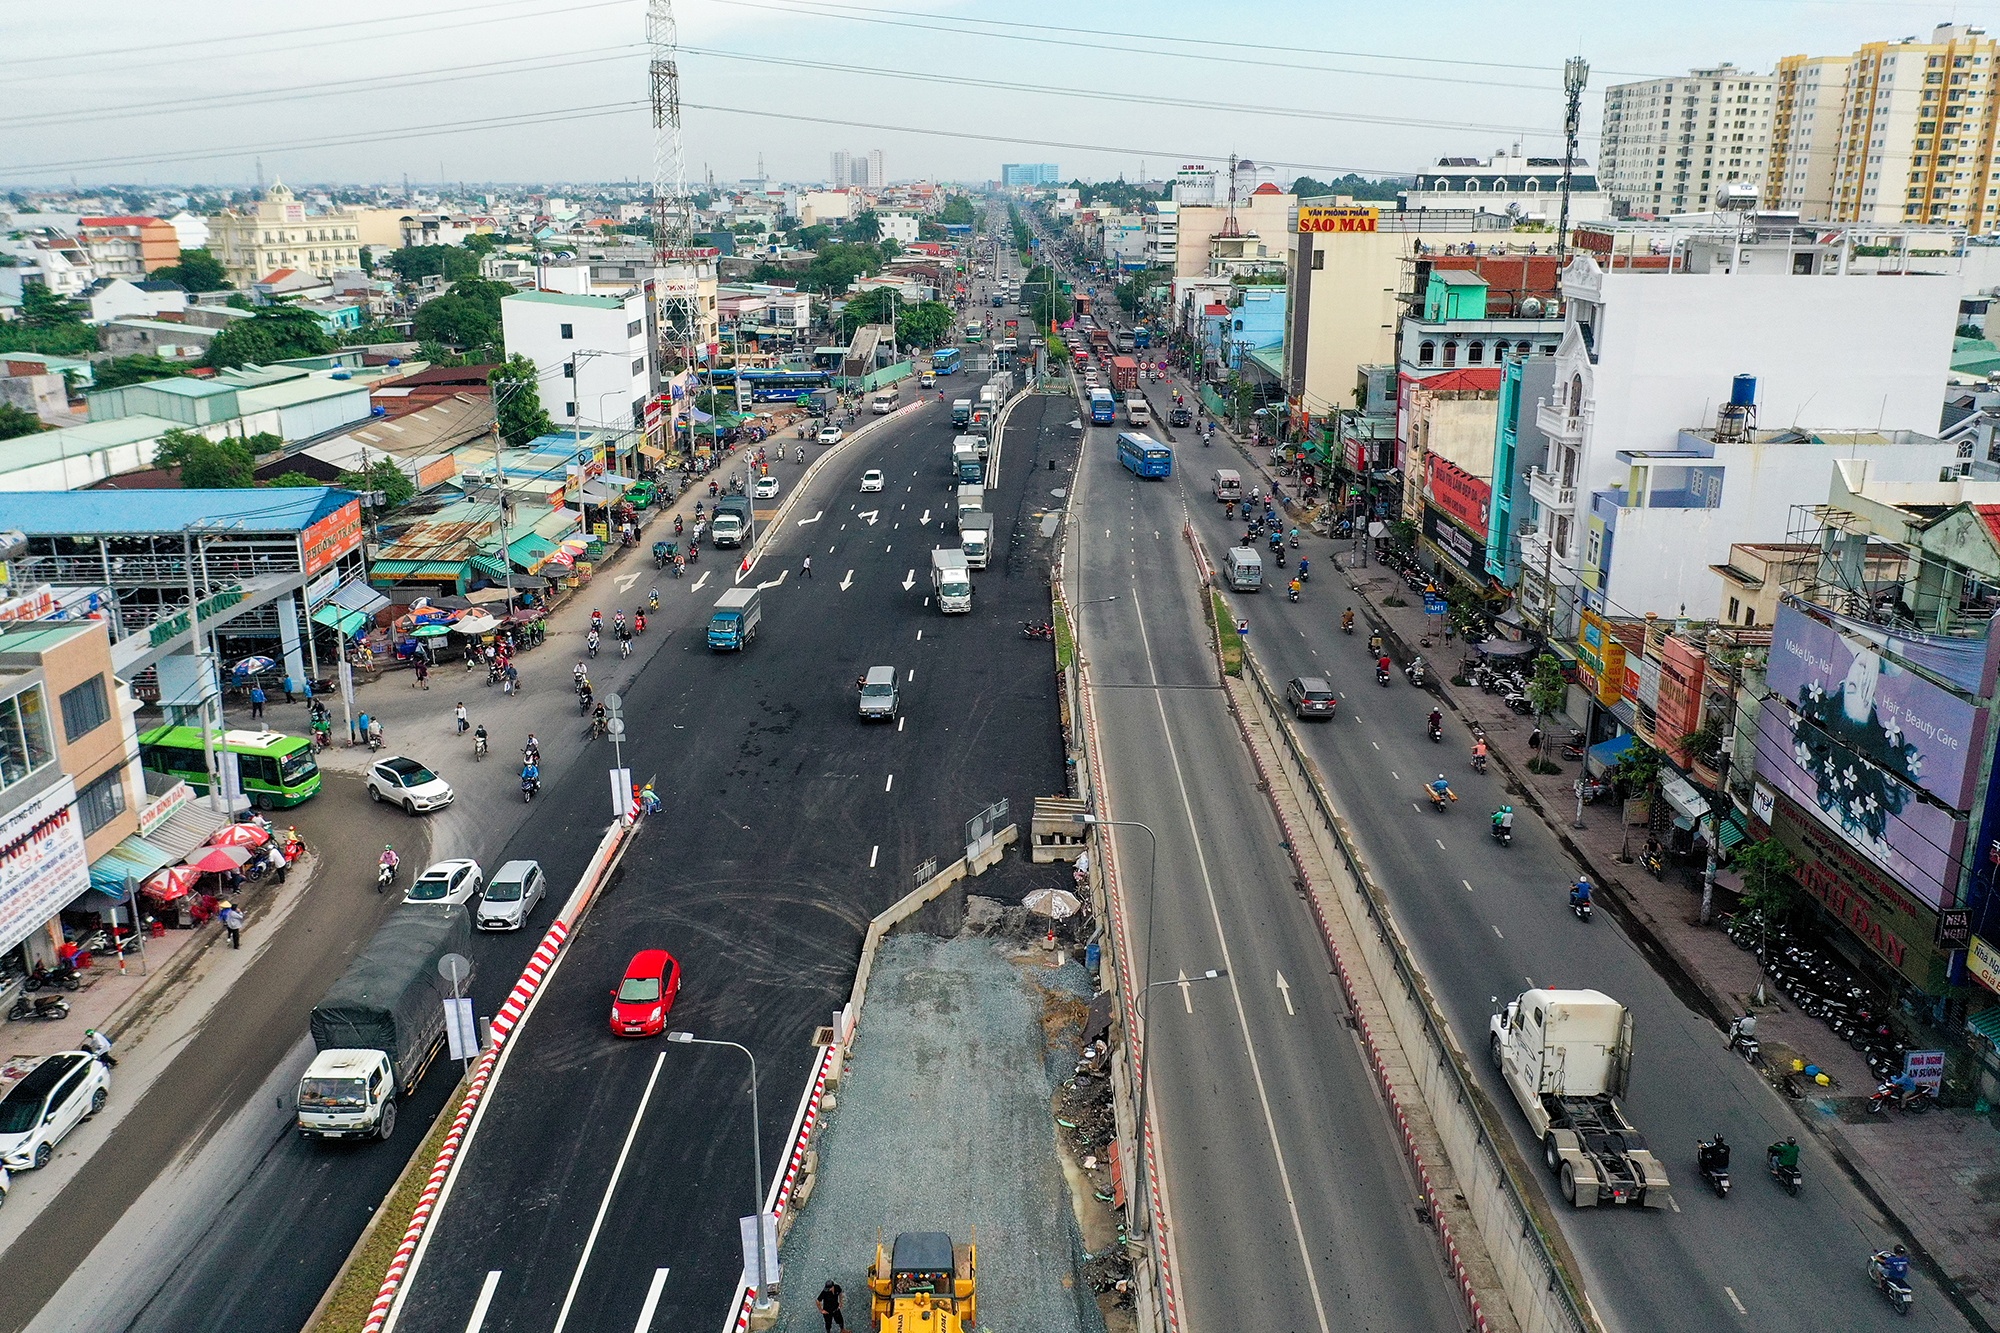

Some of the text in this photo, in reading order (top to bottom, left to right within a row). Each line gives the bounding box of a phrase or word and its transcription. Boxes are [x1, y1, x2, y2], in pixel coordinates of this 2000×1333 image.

[1308, 206, 1370, 216] VĂN PHÒNG PHẨM
[1299, 218, 1376, 232] SAO MAI
[337, 517, 361, 542] TRANG
[1784, 638, 1803, 659] Make
[1803, 649, 1815, 666] Up
[1818, 657, 1833, 676] Nail
[1882, 695, 1900, 717] Hair
[1905, 708, 1936, 739] Beauty
[1936, 728, 1959, 751] Care
